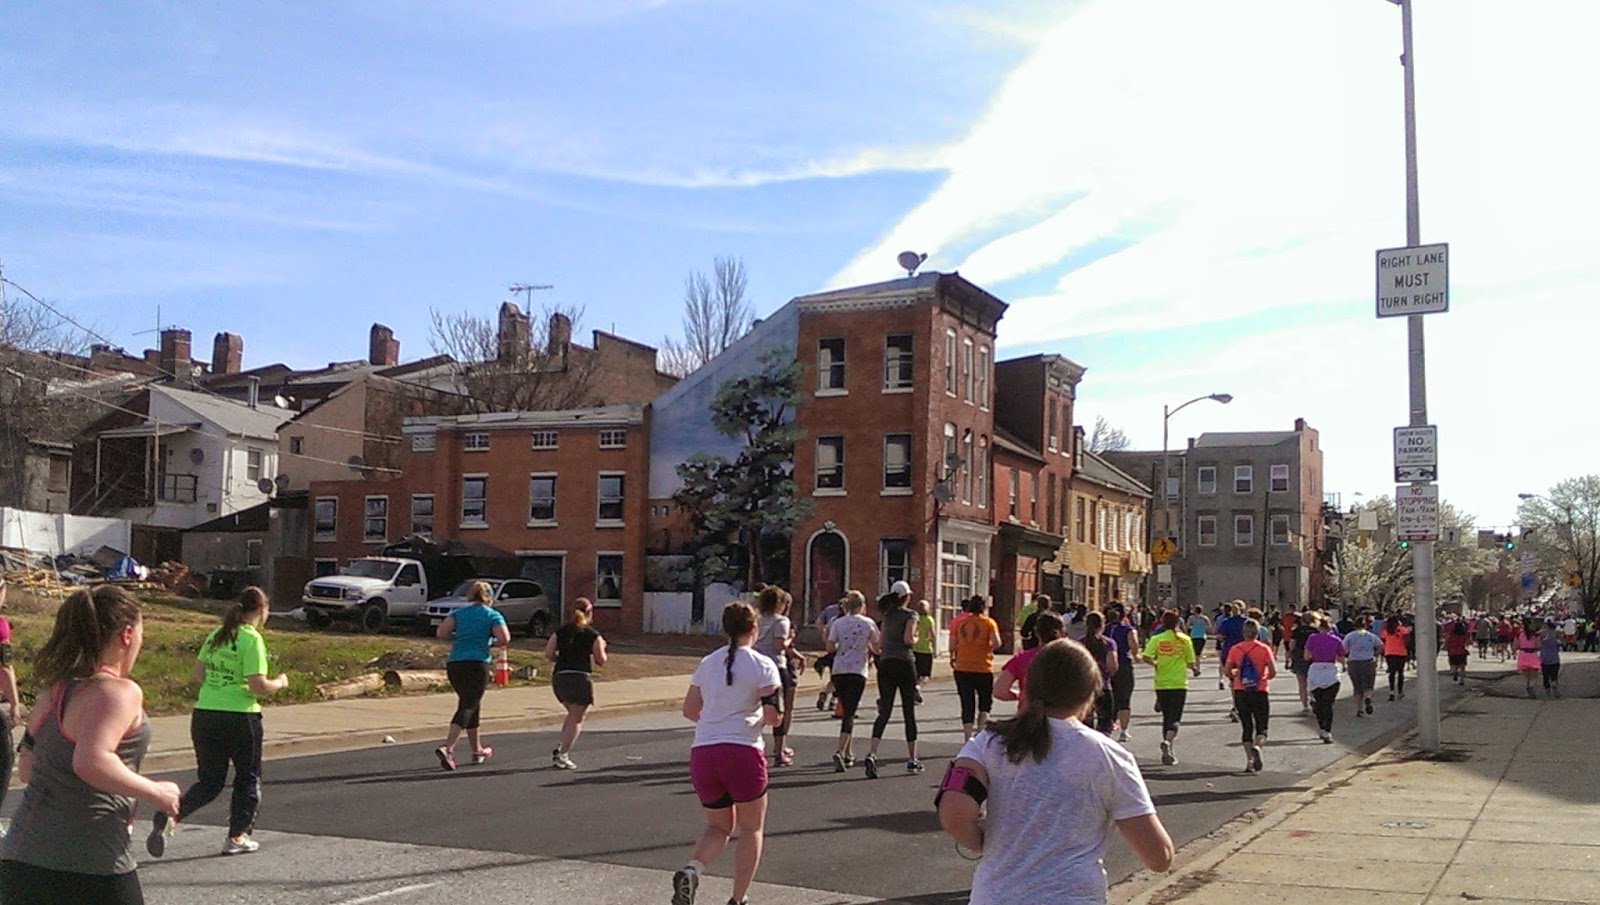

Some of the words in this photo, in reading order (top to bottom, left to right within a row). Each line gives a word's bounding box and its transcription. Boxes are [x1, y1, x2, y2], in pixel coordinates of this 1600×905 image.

[1380, 256, 1411, 268] RIGHT
[1417, 252, 1444, 265] LANE
[1394, 273, 1429, 288] MUST
[1380, 296, 1407, 308] TURN
[1413, 292, 1444, 305] RIGHT
[1407, 436, 1424, 446] NO
[1398, 446, 1434, 454] PARKING
[1411, 487, 1423, 496] NO
[1399, 496, 1436, 506] STOPPING
